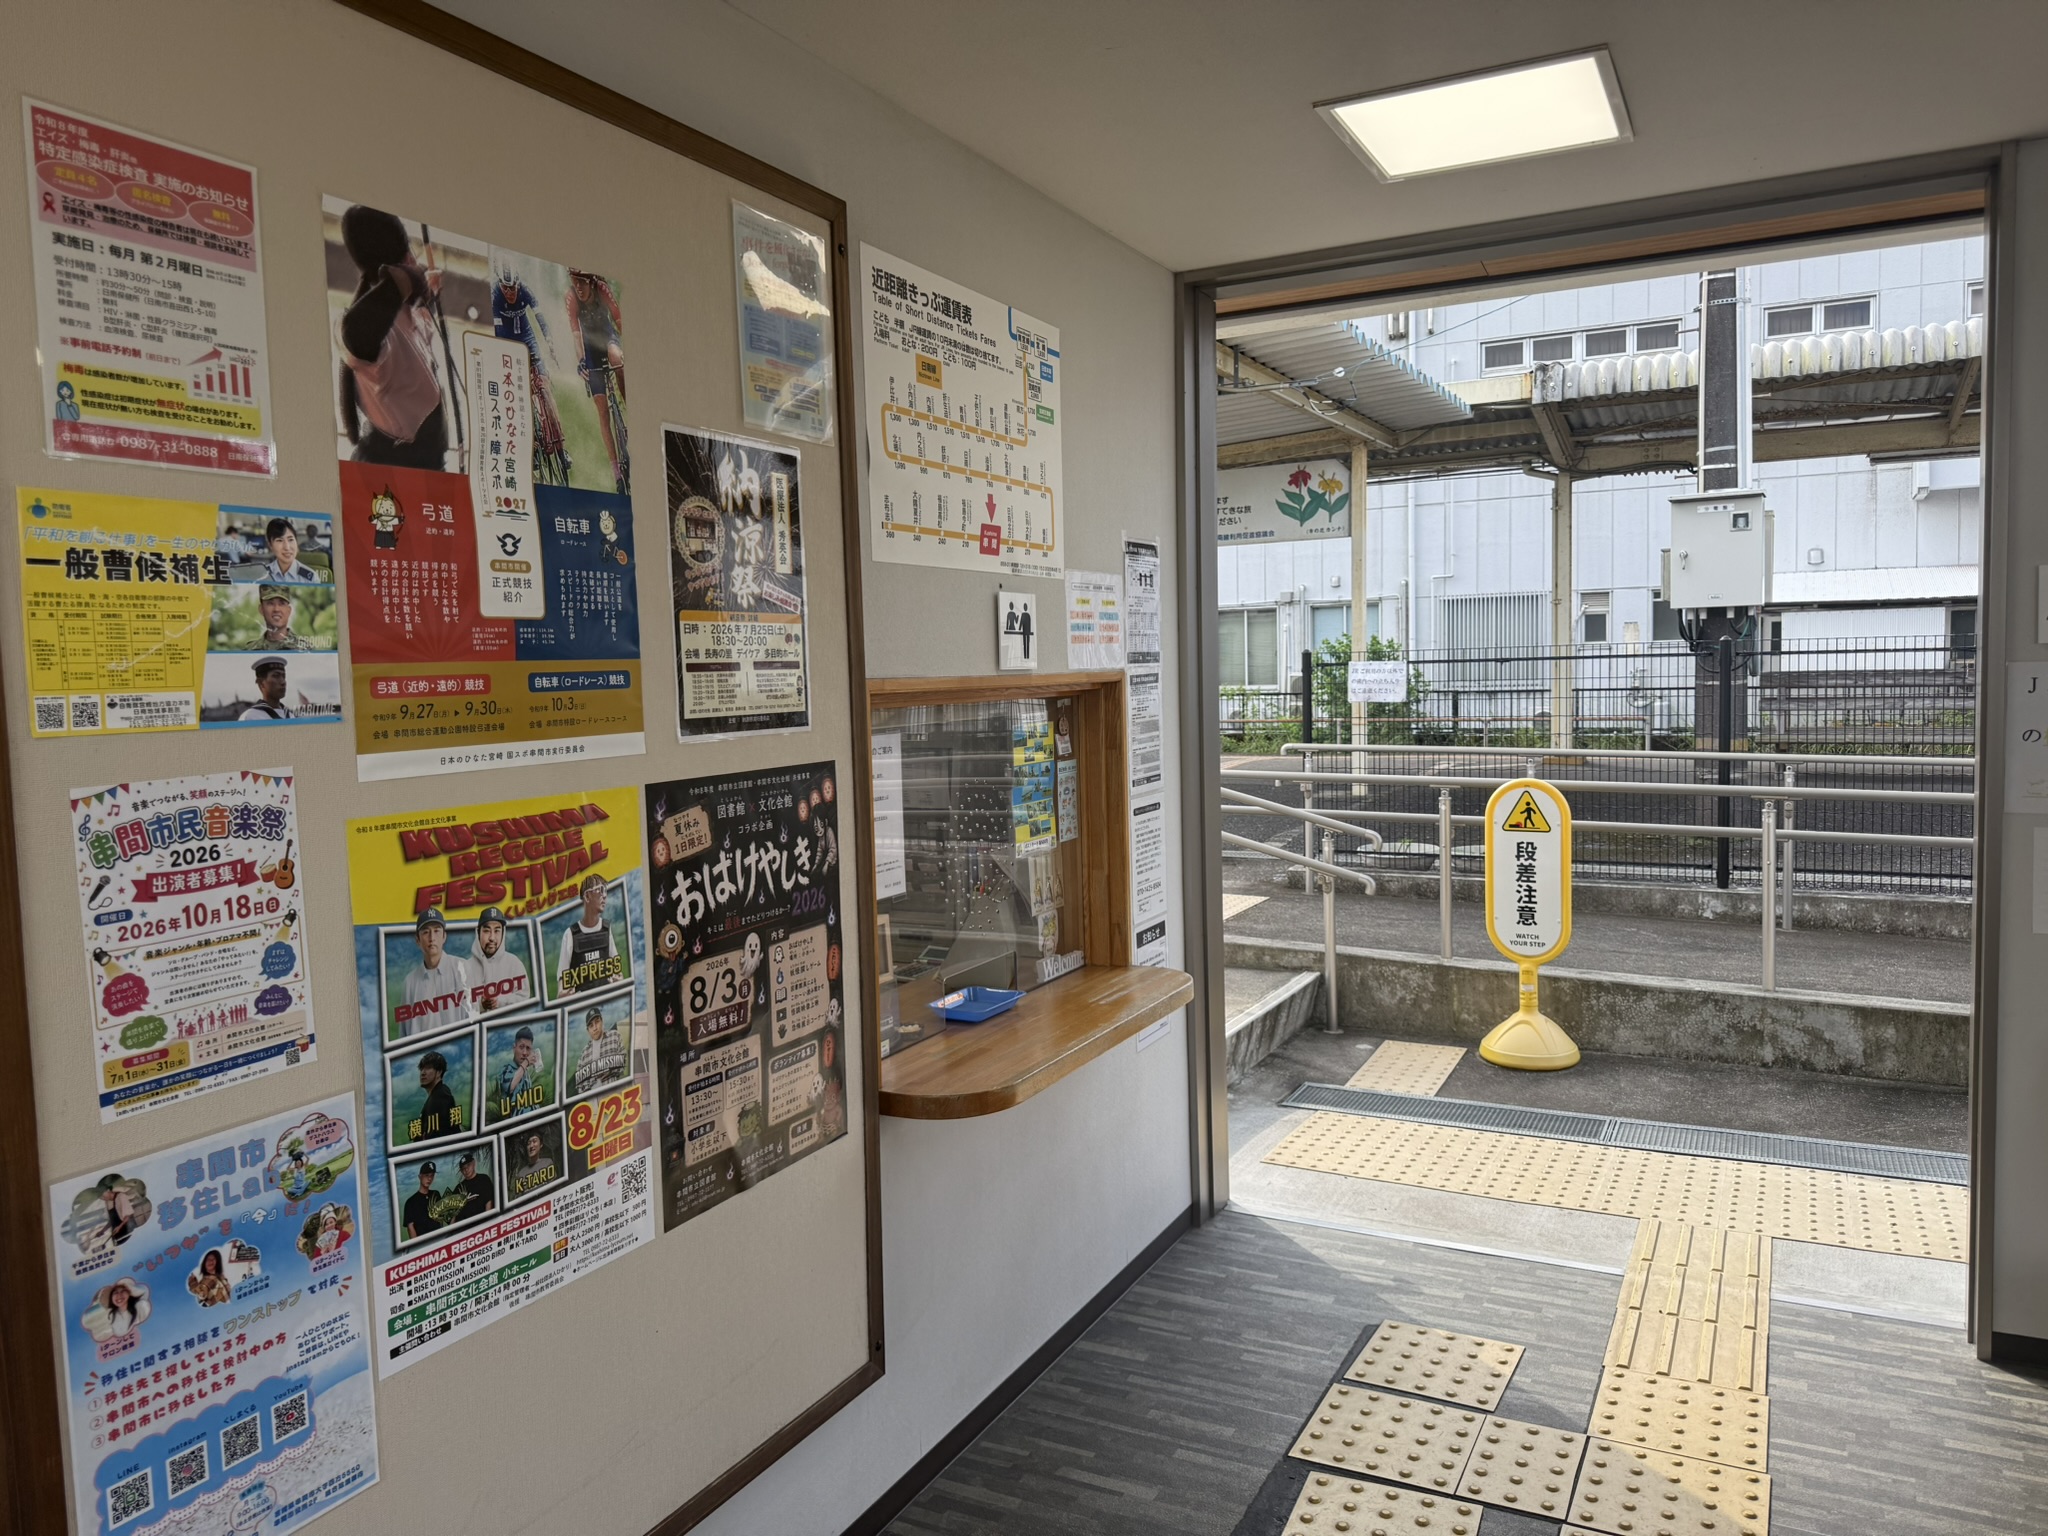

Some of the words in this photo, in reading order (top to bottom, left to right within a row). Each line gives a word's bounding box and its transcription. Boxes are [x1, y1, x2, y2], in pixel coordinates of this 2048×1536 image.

[38, 142, 149, 184] 特定感染症検査
[153, 172, 249, 211] 実施のお知らせ
[140, 251, 203, 278] 第2月曜日
[871, 266, 973, 327] 近距離きっぷ運賃表
[873, 310, 890, 324] こども
[873, 291, 893, 308] Table
[895, 301, 903, 311] of
[905, 304, 924, 321] Short
[926, 312, 954, 331] Distance
[957, 325, 978, 342] Tickets
[980, 333, 997, 348] Fares
[488, 381, 502, 490] 国スポ・障スポ
[502, 354, 518, 493] 日本のひなた宮崎
[120, 435, 218, 458] 0987-31-0888
[421, 503, 455, 523] 弓道
[554, 516, 591, 535] 自転車
[425, 527, 455, 537] 近的・遠的
[983, 537, 998, 549] 串間
[26, 546, 233, 586] 一般曹候補生
[421, 561, 430, 597] 競技です
[431, 561, 440, 606] 得点を競う
[440, 561, 451, 624] 的中した本数や
[450, 562, 460, 624] 和弓で矢を射て
[492, 576, 533, 590] 正式競技
[503, 591, 524, 604] 紹介
[296, 635, 332, 648] GROUND
[685, 648, 700, 659] 会場
[704, 648, 733, 659] 長寿の里
[736, 649, 760, 659] デイケア
[764, 648, 800, 659] 多目的ホール
[376, 677, 485, 694] 弓道（近的・遠的）競技
[534, 675, 626, 688] 自転車（ロードレース）競技
[372, 713, 397, 721] 令和9年
[529, 721, 542, 729] 会場
[546, 715, 628, 728] 串間市特設ロードレースコース
[373, 730, 389, 740] 会場
[393, 722, 505, 738] 串間市総合運動公園特設弓道会場
[440, 752, 503, 766] 日本のひなた宮崎
[506, 745, 586, 760] 国スポ串間市実行委員会
[131, 789, 247, 812] 音楽でつながる、笑顔のステージへ!
[717, 802, 746, 819] 図書館
[758, 794, 793, 812] 文化会館
[86, 802, 287, 869] 串間市民音楽祭
[399, 802, 610, 863] KUSHIMA
[674, 818, 700, 837] 夏休み
[738, 819, 773, 834] コラボ企画
[169, 844, 221, 868] 2026
[449, 828, 584, 878] REGGAE
[675, 832, 708, 854] 1日限定!
[152, 864, 242, 894] 出演者募集!
[413, 841, 609, 915] FESTIVAL
[671, 835, 811, 926] おばけやしき
[1514, 841, 1538, 926] 段差注意
[791, 885, 826, 914] 2026
[100, 911, 126, 923] 開催日
[771, 928, 785, 940] 内容
[562, 955, 622, 989] EXPRESS
[705, 956, 730, 972] 2026年
[110, 980, 134, 993] あの曲を
[110, 988, 138, 1002] ステージで
[265, 992, 283, 1000] みんなに
[394, 991, 465, 1023] BANTY
[470, 974, 527, 1003] FOOT
[690, 968, 737, 1014] 8/3
[226, 1024, 266, 1040] 串間市文化会館
[697, 1008, 746, 1036] 入場無料!
[227, 1035, 267, 1051] 串間市文化会館
[680, 1050, 696, 1063] 場所
[132, 1052, 160, 1064] 募集期間
[694, 1046, 750, 1077] 串間市文化会館
[500, 1085, 543, 1116] U-MIO
[690, 1088, 719, 1106] 13:30~
[408, 1113, 439, 1140] 横川
[568, 1084, 642, 1150] 8/23
[692, 1123, 711, 1138] 対象者
[588, 1128, 634, 1169] 日曜日
[176, 1137, 266, 1189] 串間市
[515, 1165, 555, 1193] K-TARO
[158, 1167, 281, 1231] 移住Lab
[389, 1251, 447, 1281] KUSHIMA
[451, 1230, 497, 1257] REGGAE
[500, 1207, 549, 1232] FESTIVAL
[413, 1270, 436, 1284] BANTY
[436, 1261, 456, 1277] FOOT
[466, 1244, 493, 1262] EXPRESS
[531, 1219, 549, 1233] U-MIO
[436, 1267, 465, 1284] MISSION
[515, 1233, 538, 1248] K-TARO
[425, 1271, 499, 1317] 串間市文化会館
[101, 1326, 221, 1387] 移住に関する相談を
[222, 1289, 303, 1335] ワンストップ
[103, 1333, 248, 1406] 移住先を探している方
[105, 1331, 288, 1425] 串間市への移住を検討中の方
[272, 1383, 305, 1401] YouTube
[107, 1372, 237, 1443] 串間市に移住した方
[222, 1404, 257, 1424] くしまくる
[168, 1431, 207, 1454] Instagram
[116, 1462, 140, 1480] LINE
